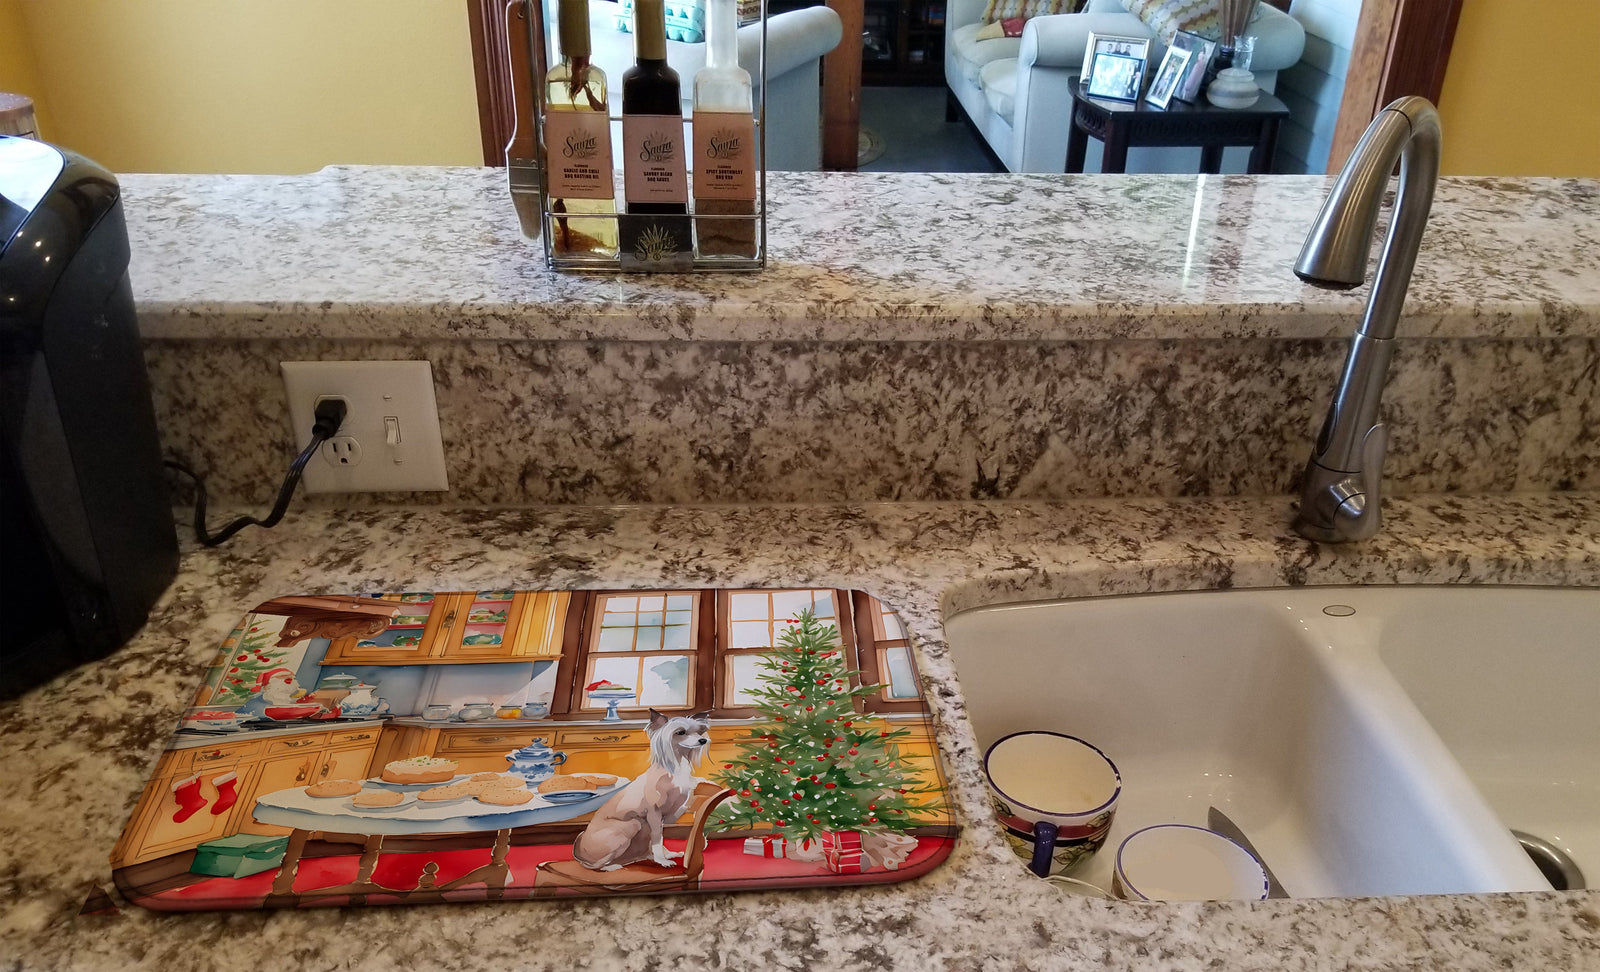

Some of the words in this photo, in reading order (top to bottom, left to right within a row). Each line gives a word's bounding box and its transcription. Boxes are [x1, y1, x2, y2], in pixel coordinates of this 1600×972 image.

[563, 136, 597, 158] Sauza
[640, 140, 673, 162] Sauza
[707, 137, 739, 159] Sauza
